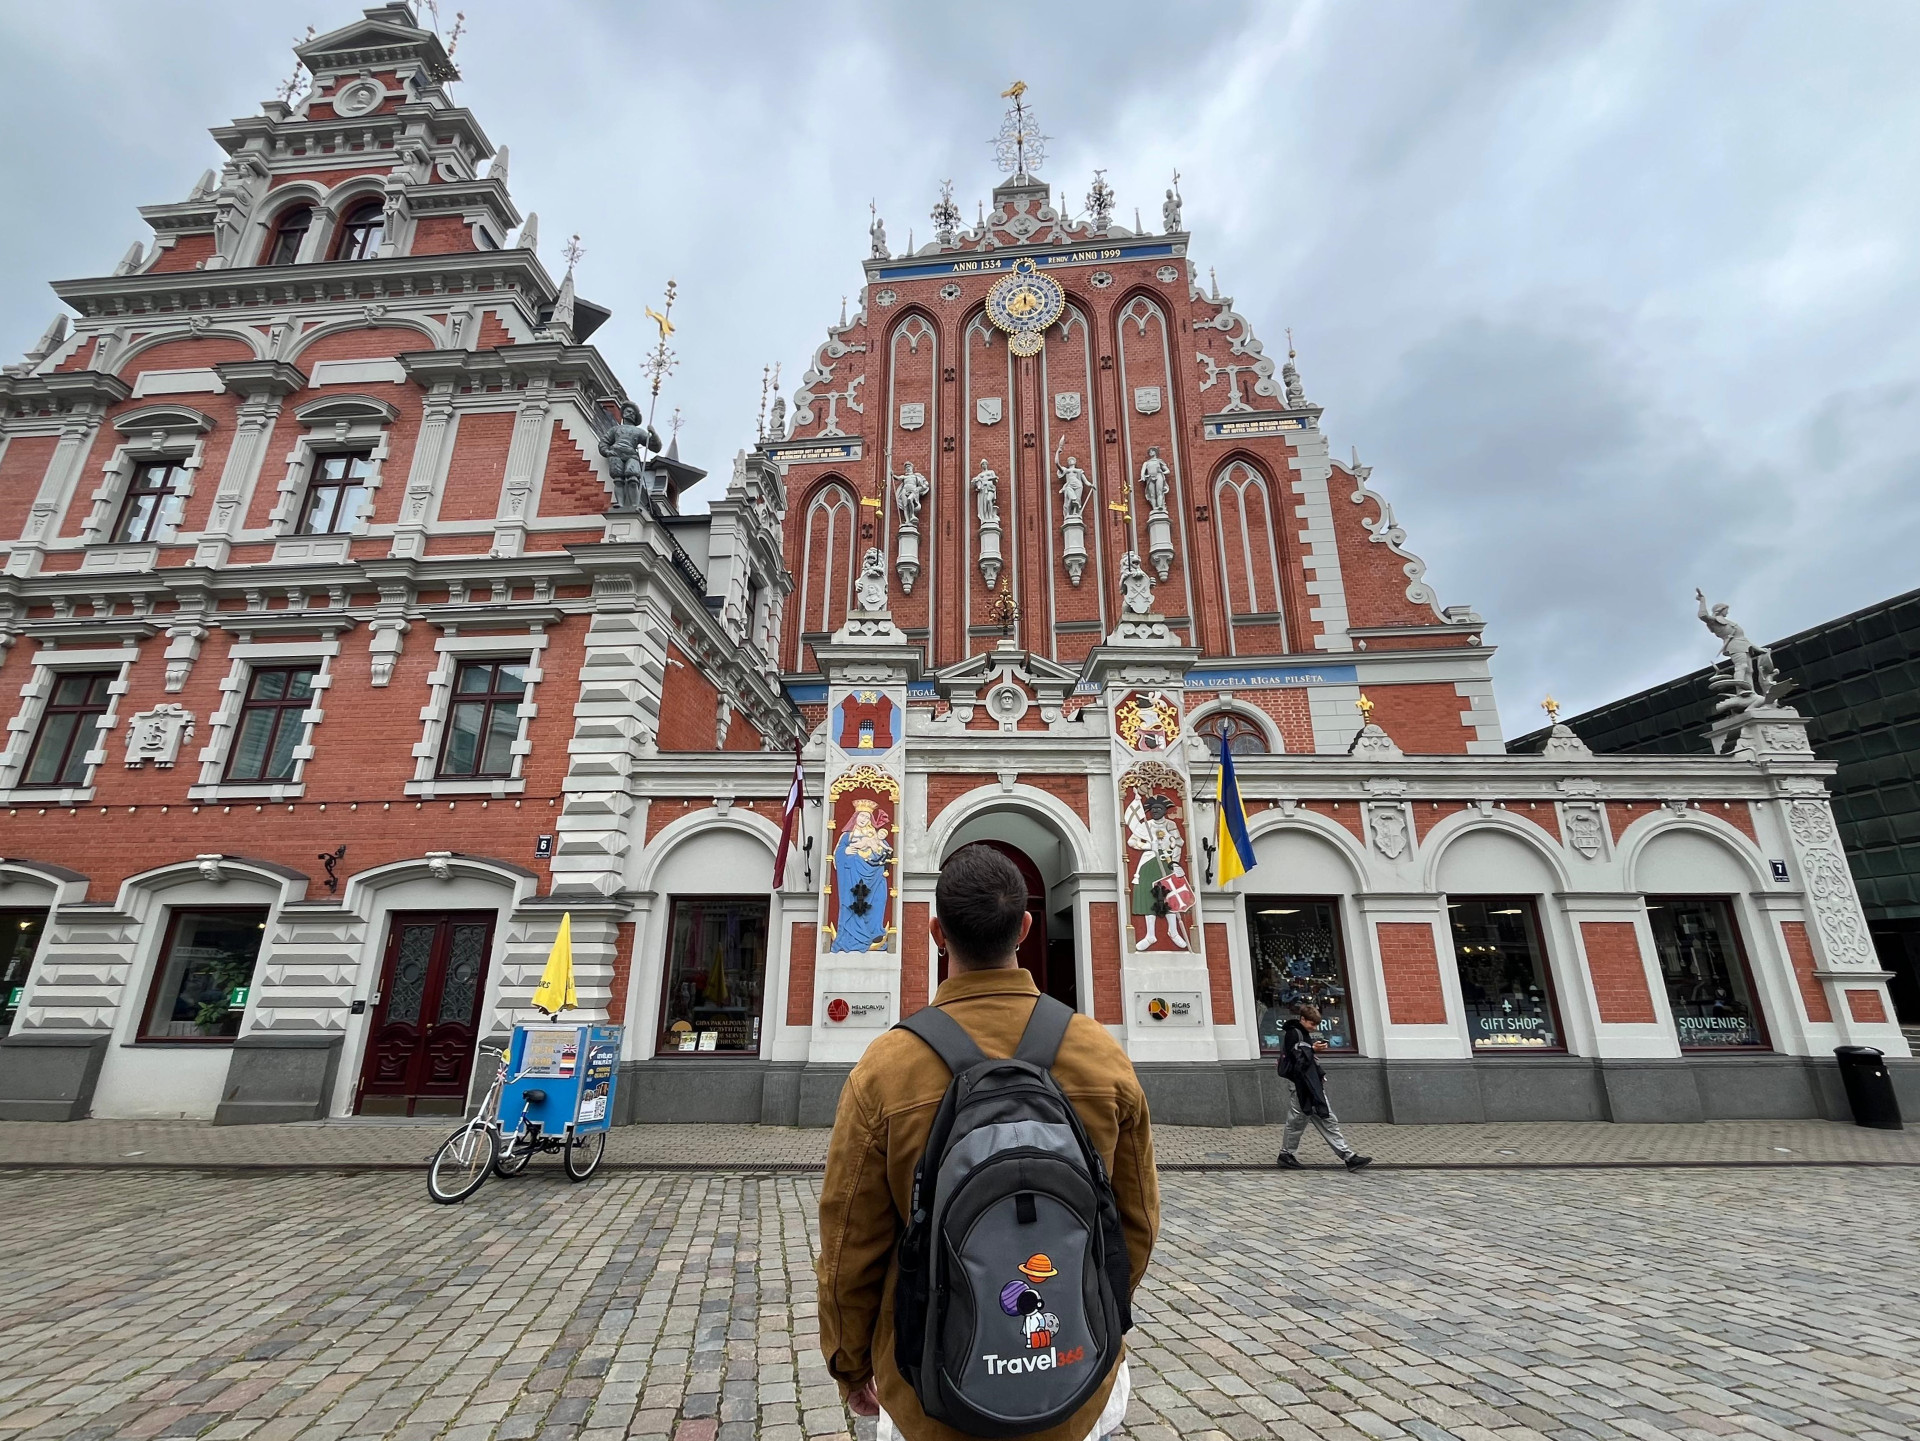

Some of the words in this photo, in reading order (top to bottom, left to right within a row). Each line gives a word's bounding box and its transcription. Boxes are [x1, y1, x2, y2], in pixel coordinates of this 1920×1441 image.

[1071, 251, 1097, 261] ANNO
[1100, 249, 1121, 259] 1999
[952, 261, 977, 271] ANNO
[980, 260, 1001, 269] 1334
[1251, 676, 1280, 685] RĪGAS
[540, 840, 547, 850] 6
[1776, 864, 1782, 874] 7
[1480, 1018, 1504, 1030] GIFT
[1507, 1018, 1540, 1030] SHOP
[1679, 1017, 1747, 1029] SOUVENIRS
